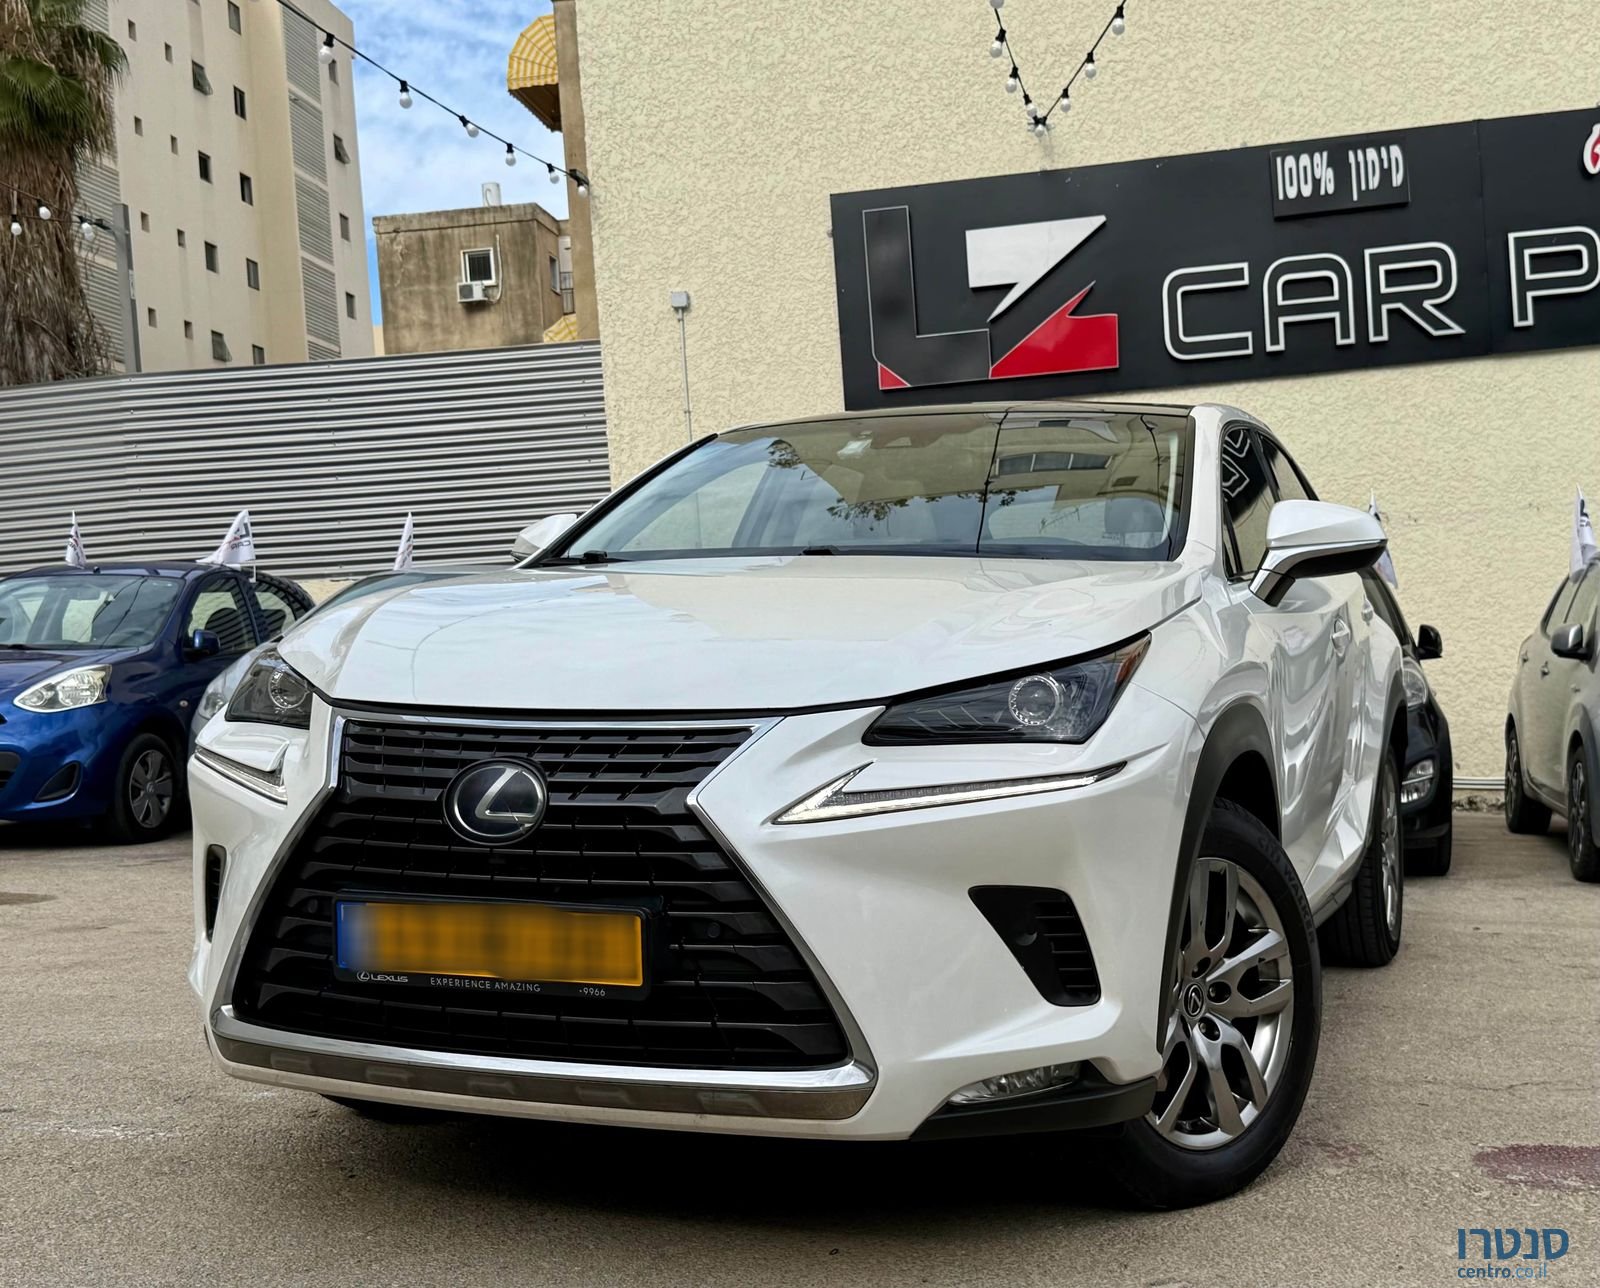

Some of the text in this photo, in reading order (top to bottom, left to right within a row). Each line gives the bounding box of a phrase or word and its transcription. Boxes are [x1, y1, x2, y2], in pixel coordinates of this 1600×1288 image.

[1276, 144, 1404, 201] מימון 100%
[1162, 241, 1467, 361] CAR
[370, 973, 409, 983] LEXUS
[430, 977, 541, 993] EXPERIENCE AMAZING
